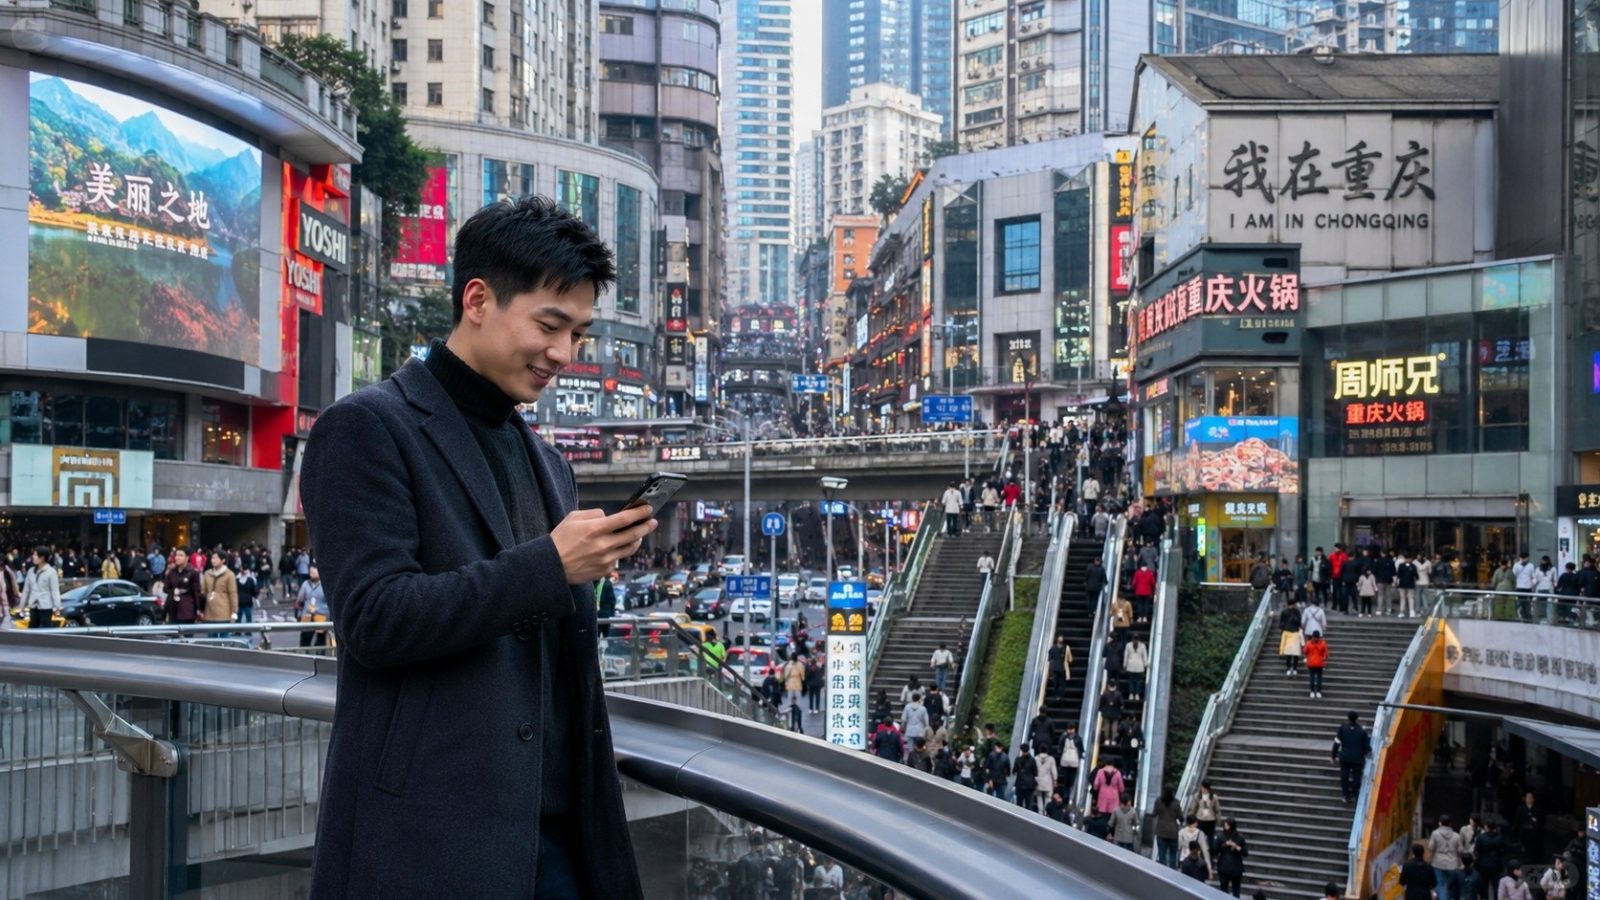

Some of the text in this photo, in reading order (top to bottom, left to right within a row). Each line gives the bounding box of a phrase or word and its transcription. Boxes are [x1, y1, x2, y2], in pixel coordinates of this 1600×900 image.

[1224, 140, 1435, 204] 我在重庆
[86, 163, 211, 229] 美丽之地
[301, 212, 346, 265] YOSHI
[1230, 213, 1429, 230] I AM IN CHONGQING
[285, 256, 320, 296] YOSHI
[1334, 355, 1440, 400] 周师兄
[1345, 401, 1425, 425] 重庆火锅
